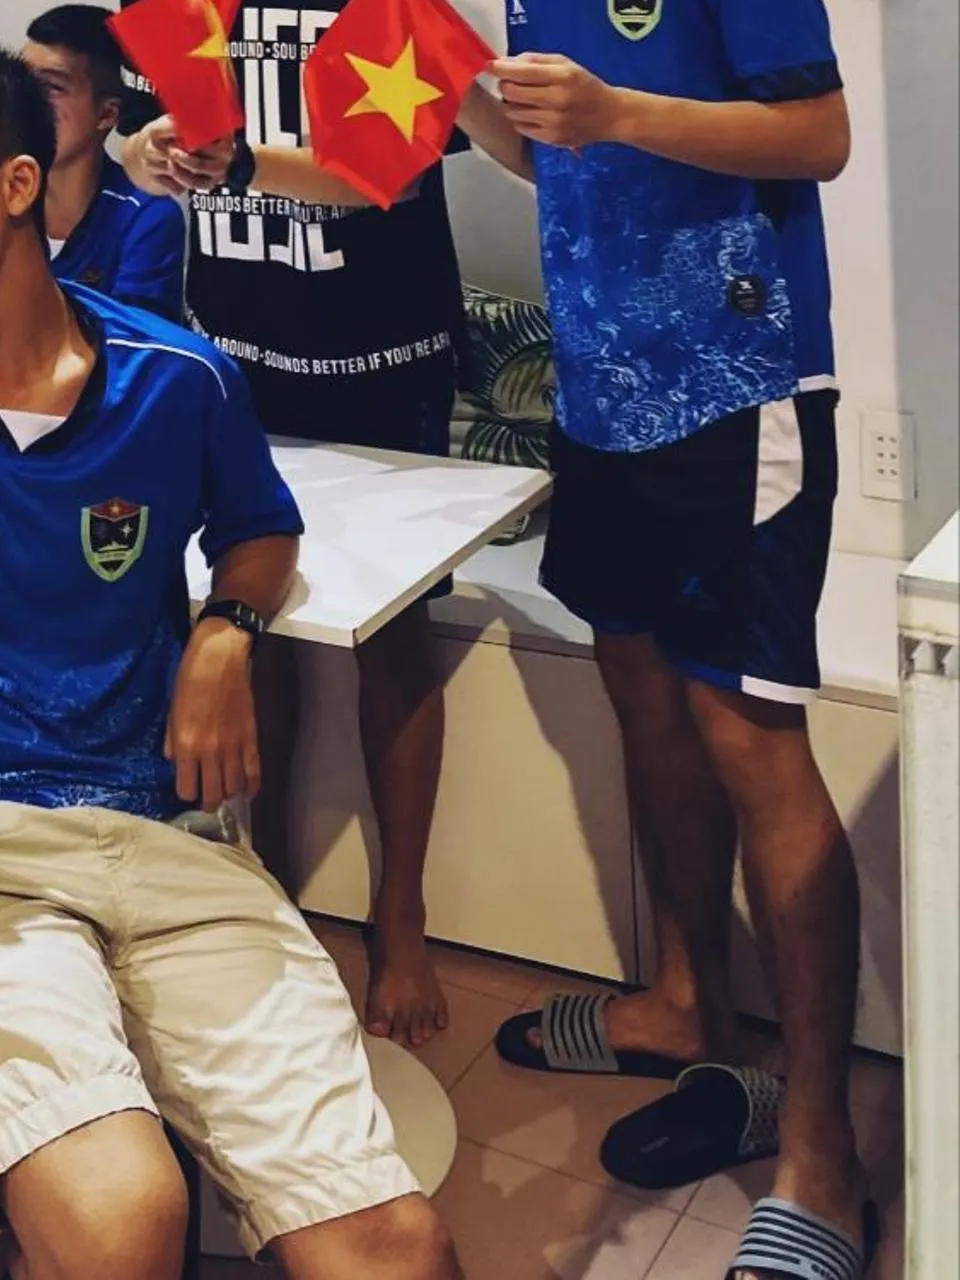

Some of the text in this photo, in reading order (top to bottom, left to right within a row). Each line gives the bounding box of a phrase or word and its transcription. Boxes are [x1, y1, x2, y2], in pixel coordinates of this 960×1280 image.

[192, 193, 241, 212] SOUNDS
[312, 356, 366, 375] BETTER
[367, 352, 381, 371] IF
[382, 338, 431, 366] YOU'RE
